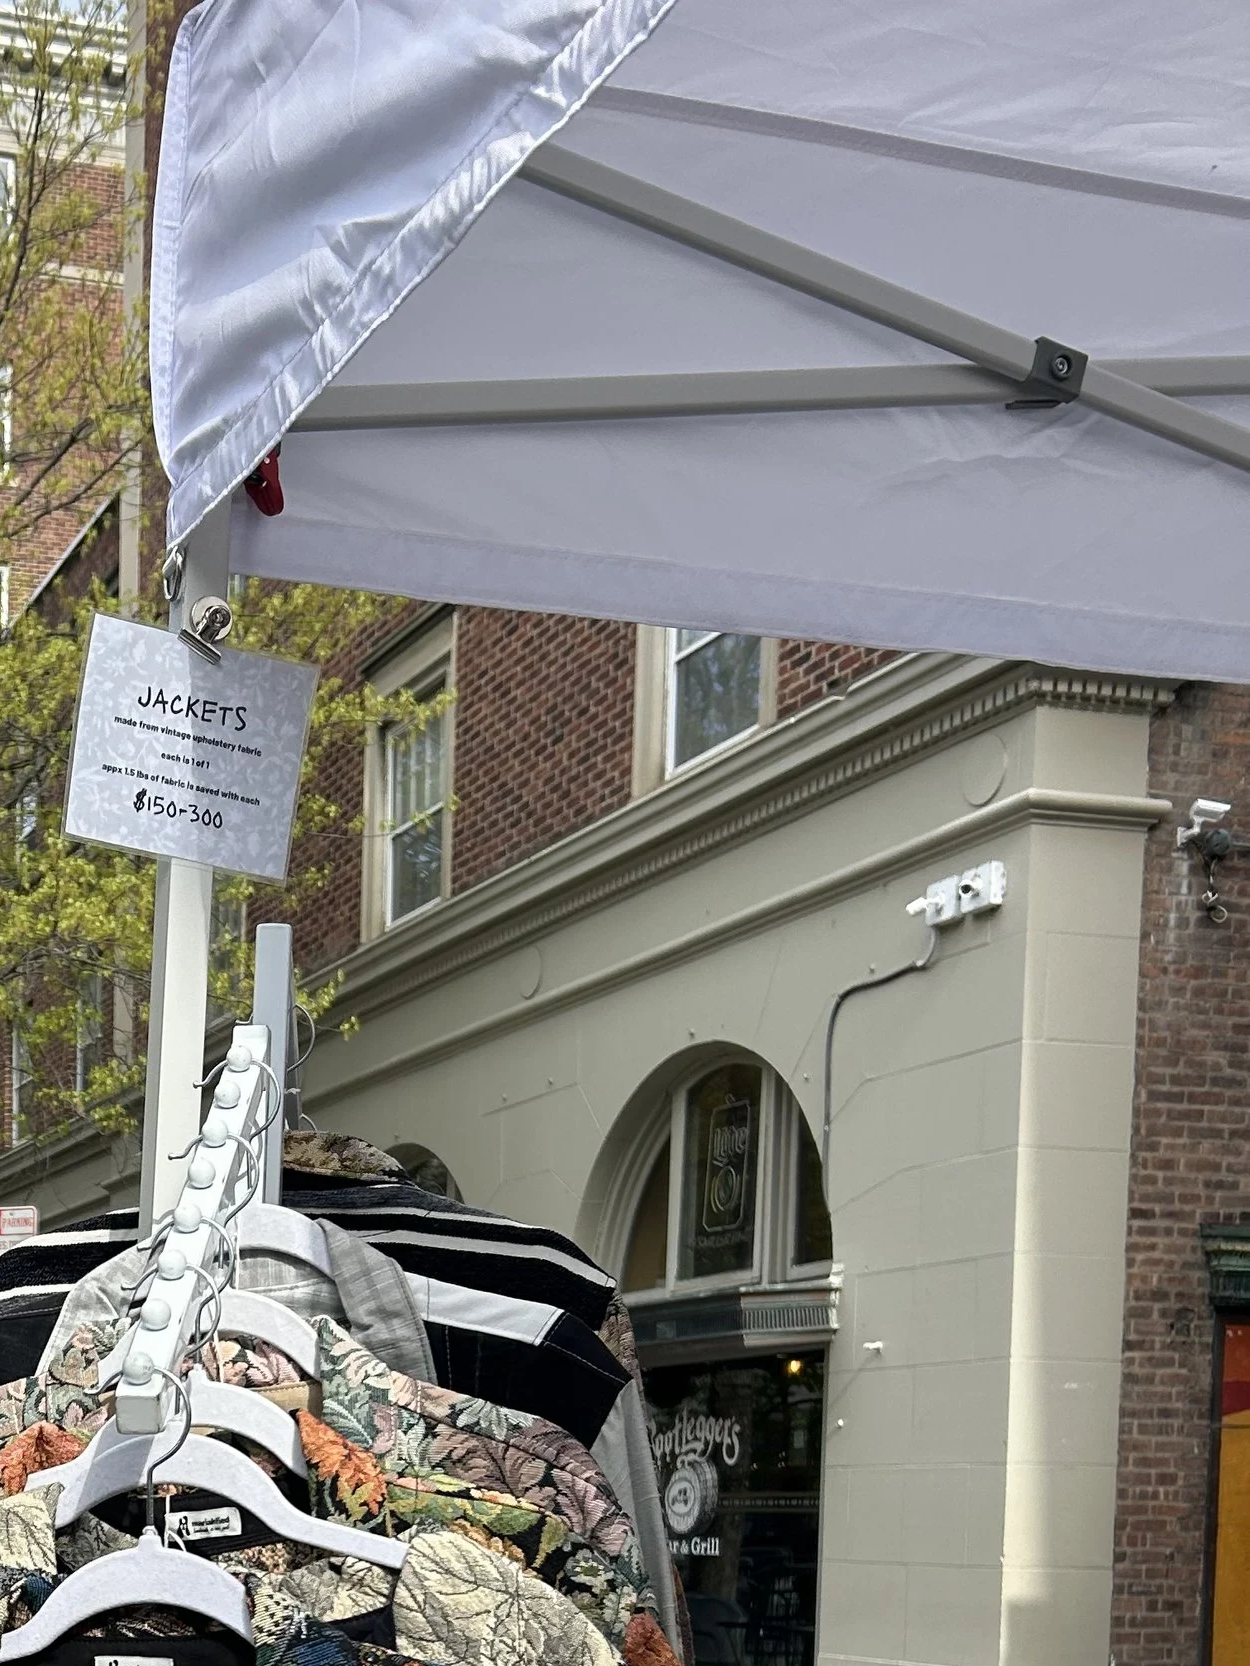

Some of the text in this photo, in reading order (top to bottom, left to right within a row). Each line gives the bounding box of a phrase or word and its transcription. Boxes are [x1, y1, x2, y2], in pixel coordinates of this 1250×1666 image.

[138, 686, 248, 732] JACKETS
[114, 715, 262, 757] made from vintage upholstery fabric
[161, 752, 181, 764] each
[182, 755, 191, 765] is
[196, 759, 206, 769] of
[102, 763, 261, 807] appx 1.5 lbs of fabric is saved with each
[133, 788, 223, 830] $150-300
[1, 1217, 34, 1228] PARKING
[680, 1539, 690, 1555] &
[691, 1536, 720, 1557] Grill
